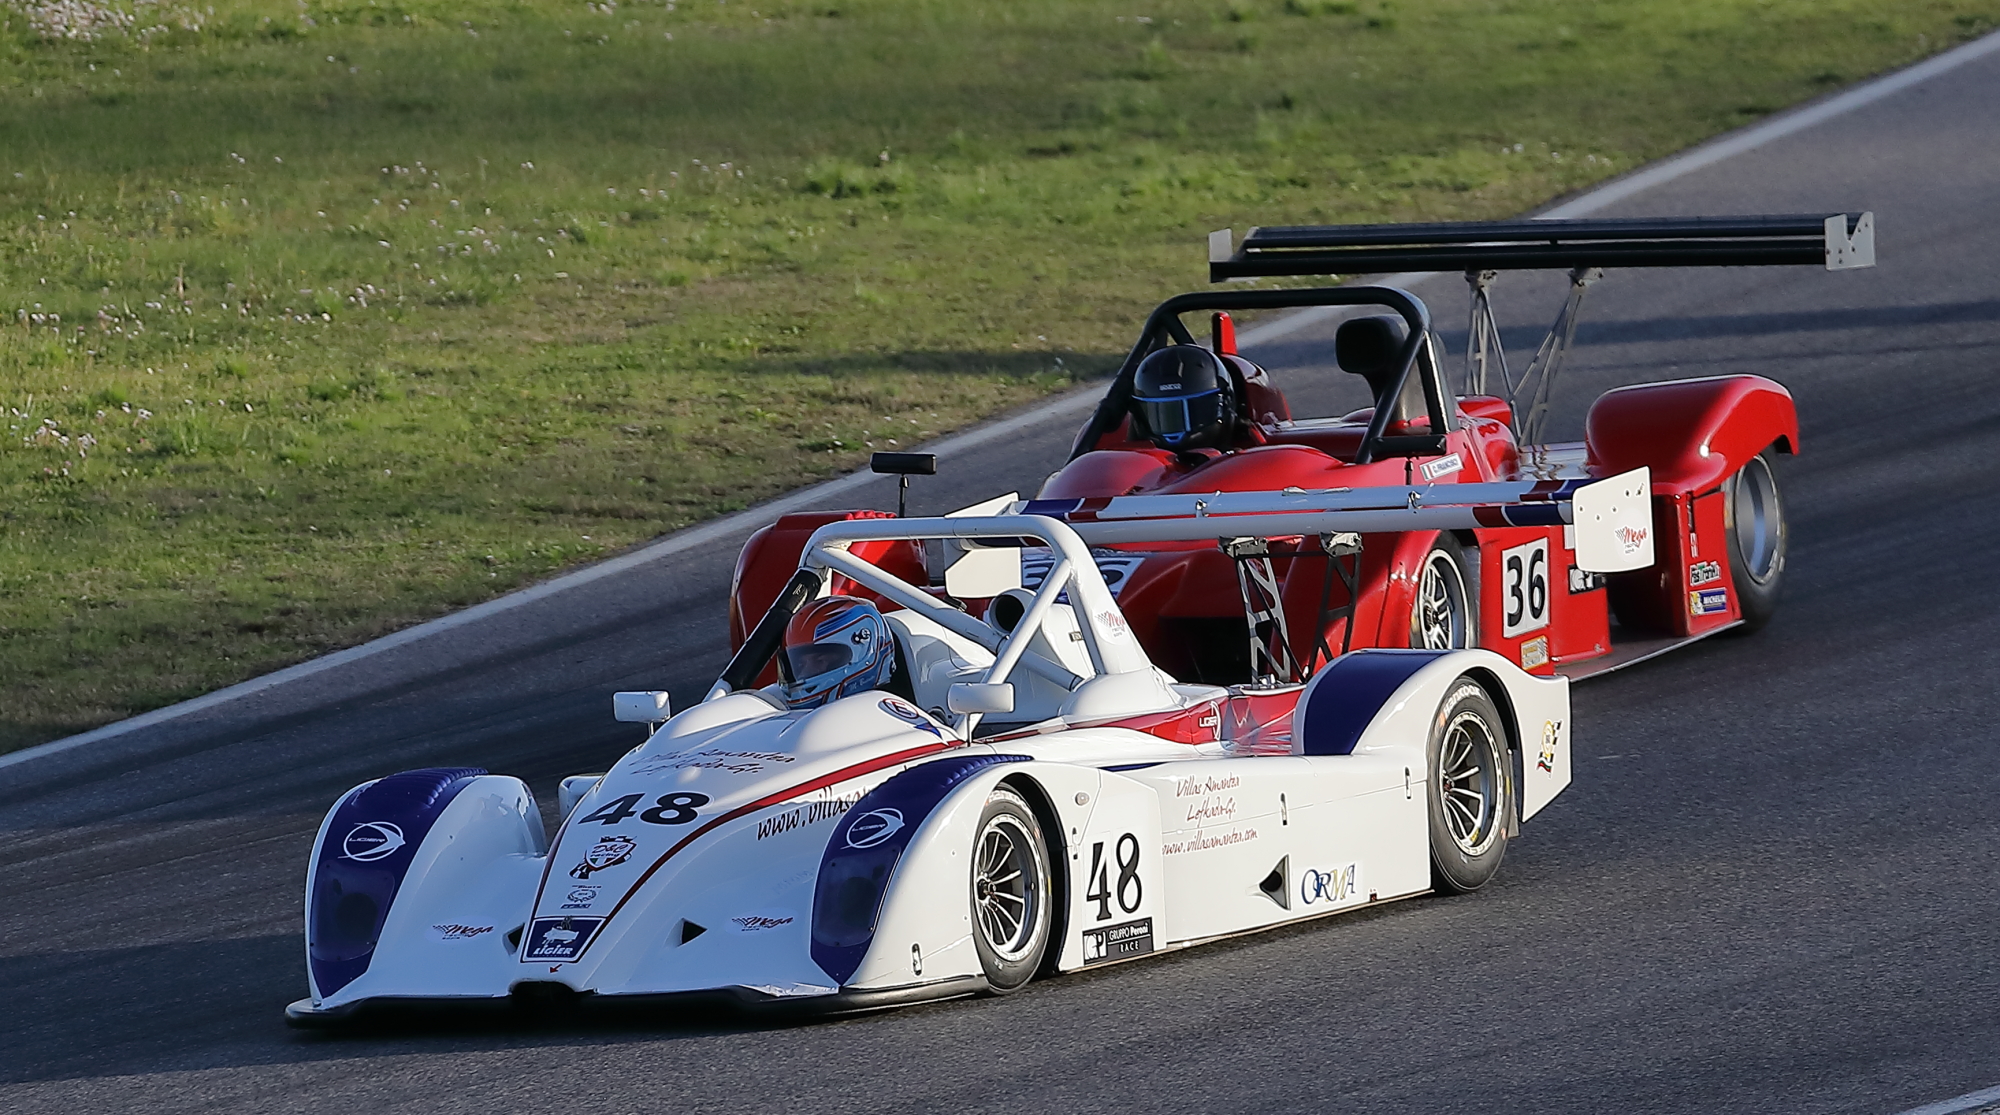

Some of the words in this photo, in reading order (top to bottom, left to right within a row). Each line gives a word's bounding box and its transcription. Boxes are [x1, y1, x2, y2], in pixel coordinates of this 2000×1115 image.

[1506, 548, 1546, 628] 36
[1176, 775, 1202, 797] Villas
[577, 791, 711, 826] 48
[1086, 832, 1142, 921] 48
[1301, 862, 1357, 905] ORMA
[1109, 926, 1130, 941] GRUPPO
[1130, 922, 1149, 937] Peroni
[533, 944, 574, 955] LIGIER
[1120, 940, 1139, 953] RACE
